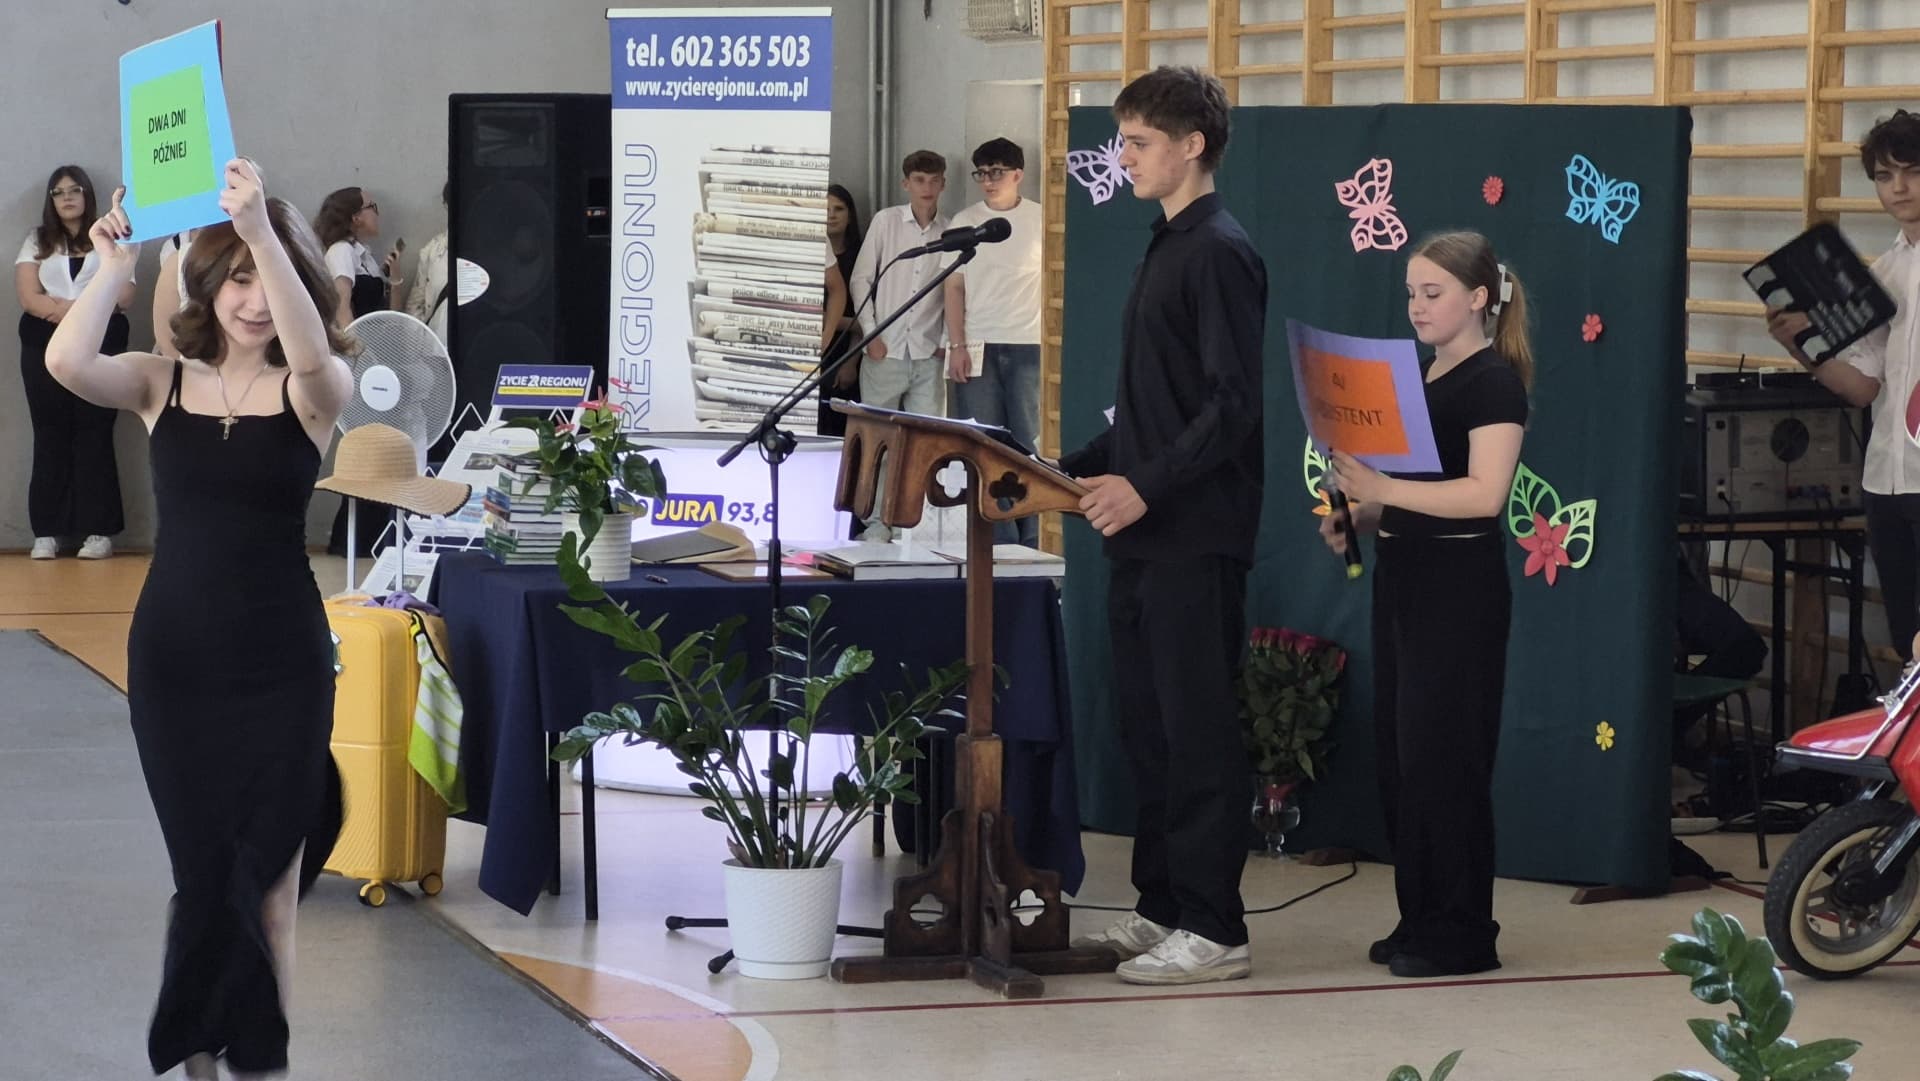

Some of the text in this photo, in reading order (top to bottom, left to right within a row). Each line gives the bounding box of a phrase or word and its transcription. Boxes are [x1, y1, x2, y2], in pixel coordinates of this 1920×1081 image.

[626, 34, 811, 67] tel. 602 365 503
[625, 76, 809, 102] www.zycieregionu.com.pl
[148, 108, 186, 134] DWA DNI
[153, 140, 187, 165] PÓŹNIEJ
[618, 143, 658, 432] REGIONU
[540, 376, 587, 387] REGIONU
[655, 499, 718, 522] JURA
